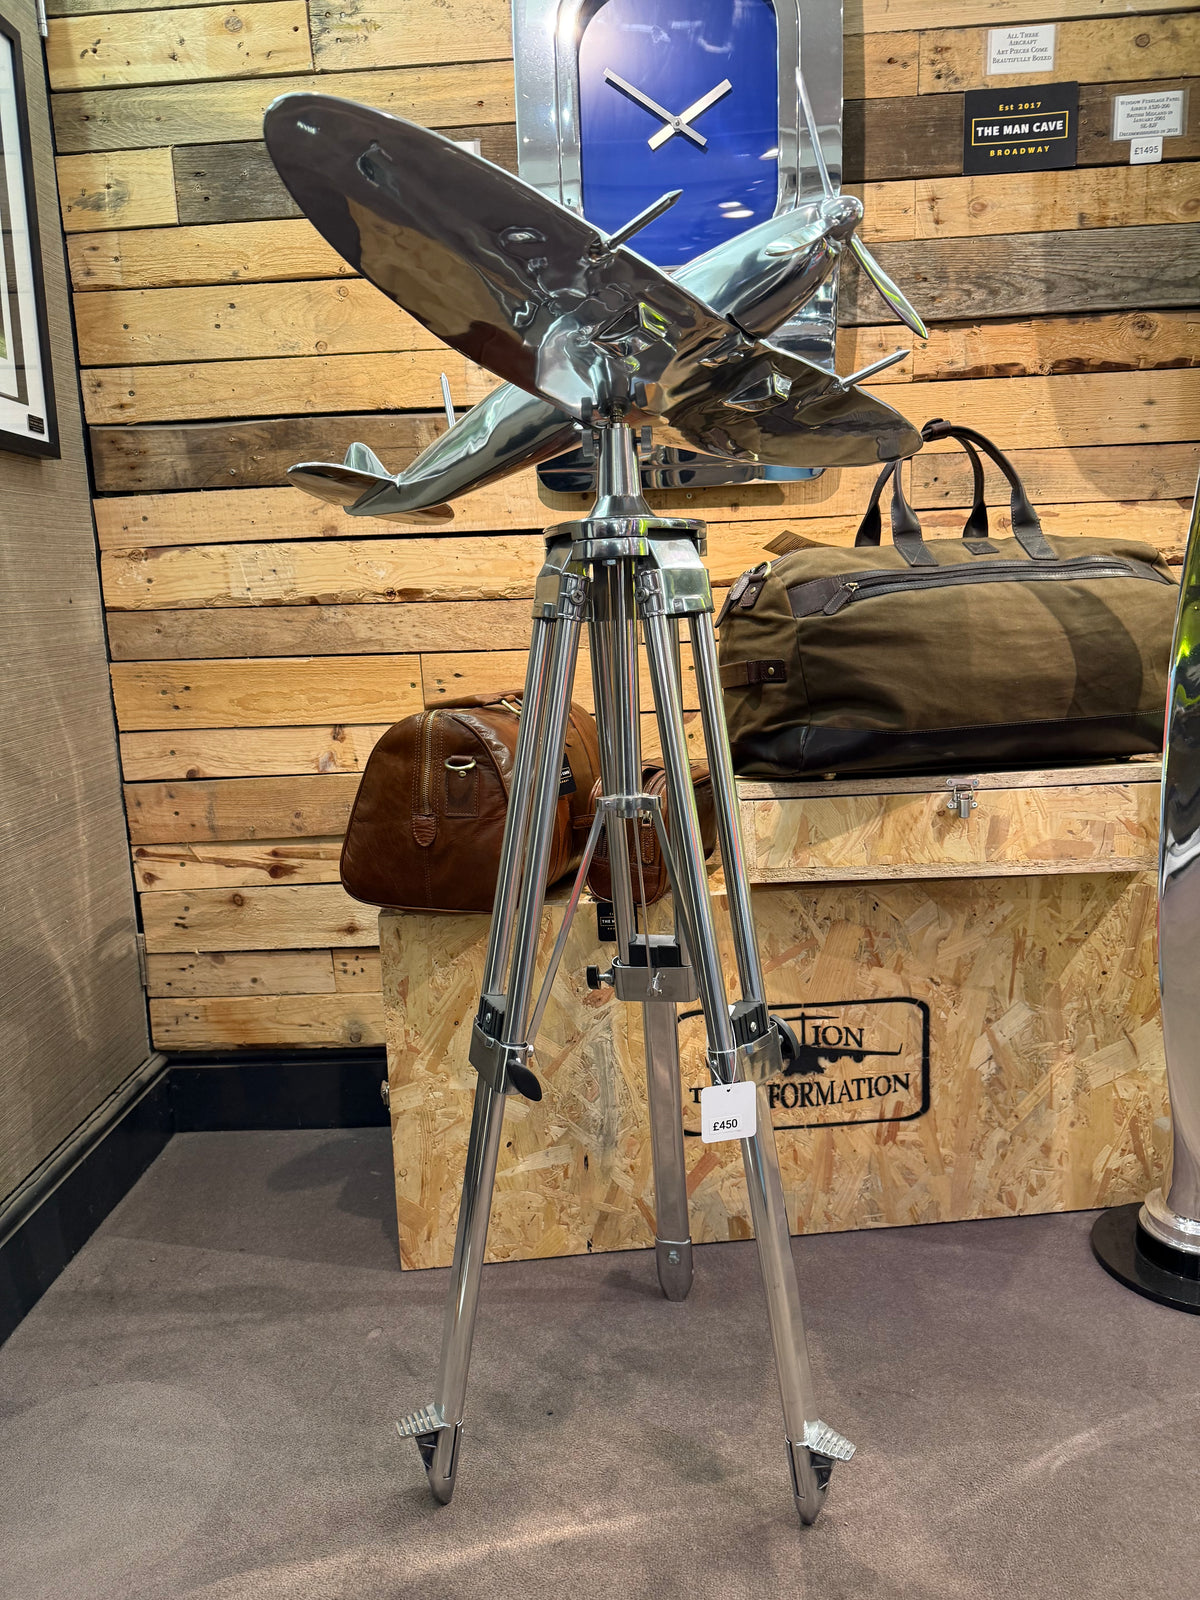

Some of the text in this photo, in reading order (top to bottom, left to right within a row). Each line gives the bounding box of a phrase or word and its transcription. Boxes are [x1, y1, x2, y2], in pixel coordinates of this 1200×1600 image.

[1017, 101, 1042, 110] 2017
[976, 120, 1064, 137] THE MAN CAVE
[989, 145, 1050, 157] BROADWAY
[1134, 145, 1159, 155] £1495
[713, 1118, 738, 1131] £450
